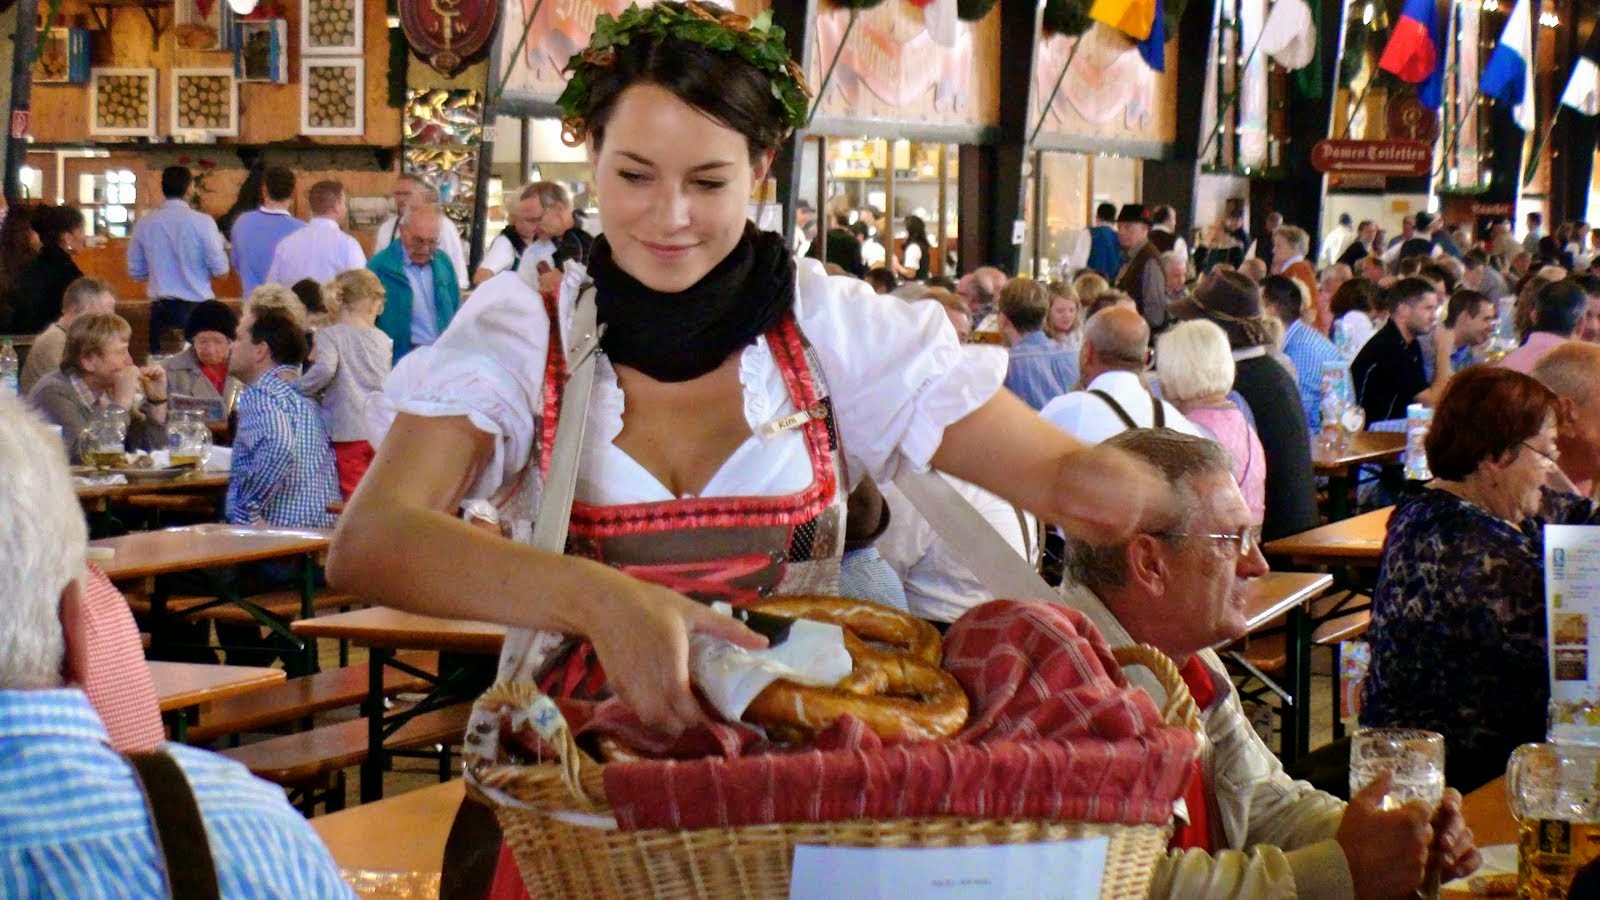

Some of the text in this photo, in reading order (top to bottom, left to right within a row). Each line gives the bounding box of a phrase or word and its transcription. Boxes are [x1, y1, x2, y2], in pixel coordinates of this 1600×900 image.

[1322, 144, 1426, 161] Damen Toiletten
[778, 417, 797, 429] Kim
